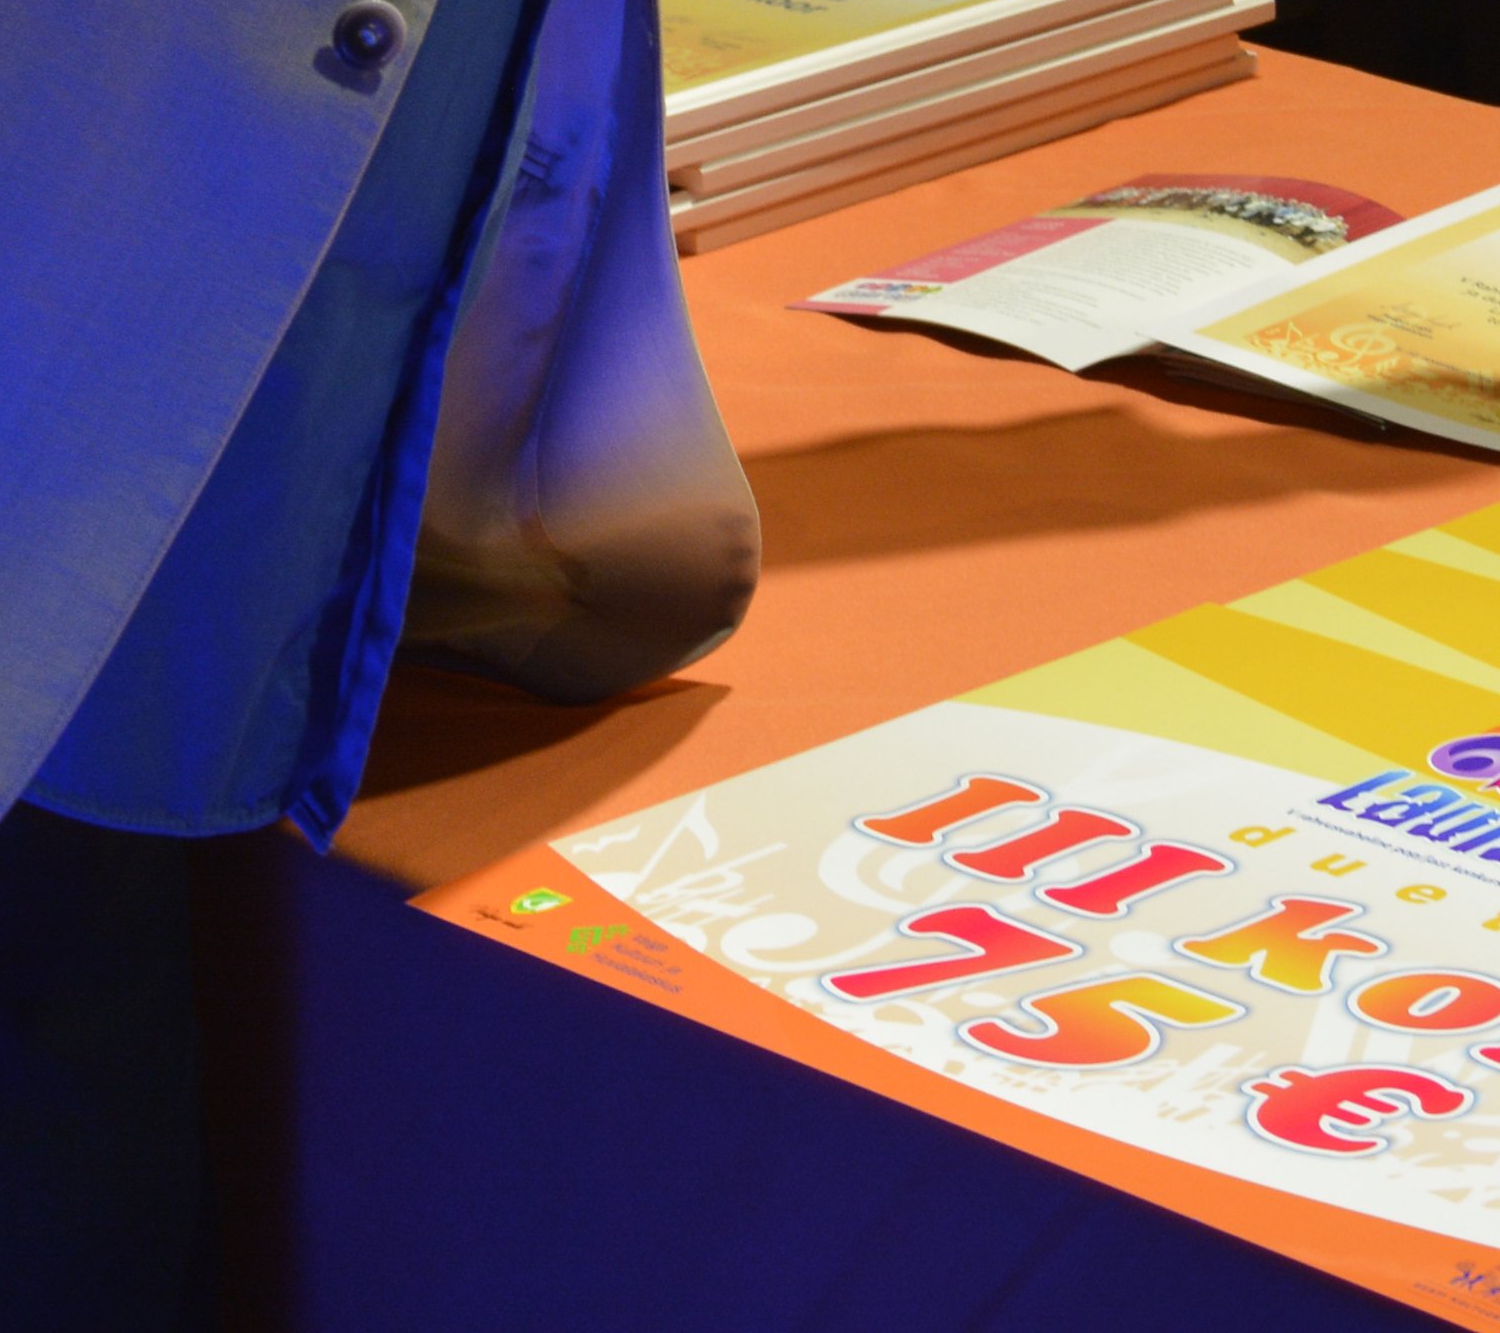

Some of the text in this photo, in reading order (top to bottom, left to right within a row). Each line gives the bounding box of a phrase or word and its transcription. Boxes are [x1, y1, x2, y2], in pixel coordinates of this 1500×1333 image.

[852, 770, 1237, 919] III
[821, 903, 1249, 1070] 75
[1240, 1062, 1476, 1158] €
